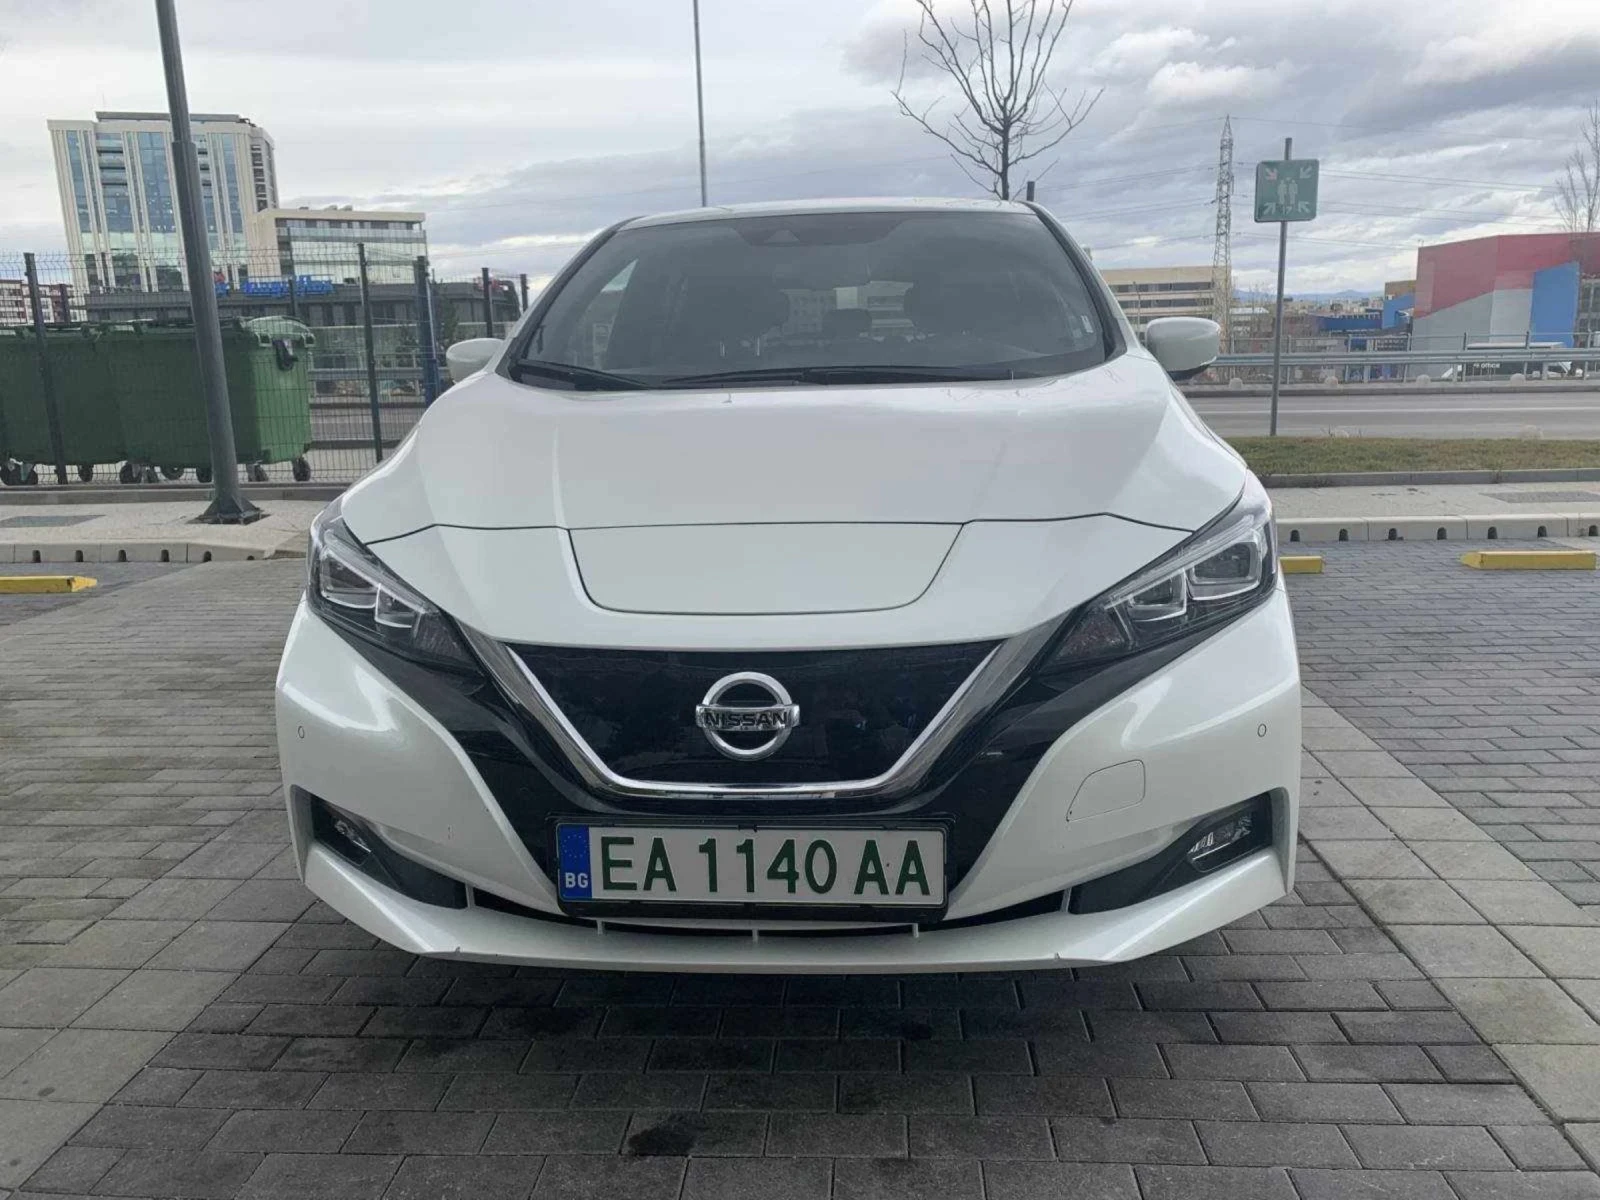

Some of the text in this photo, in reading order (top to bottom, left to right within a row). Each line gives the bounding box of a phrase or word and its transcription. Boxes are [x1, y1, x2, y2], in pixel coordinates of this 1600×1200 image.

[704, 711, 787, 726] NISSAN
[601, 836, 931, 896] EA 1140 AA
[565, 872, 589, 888] BG
